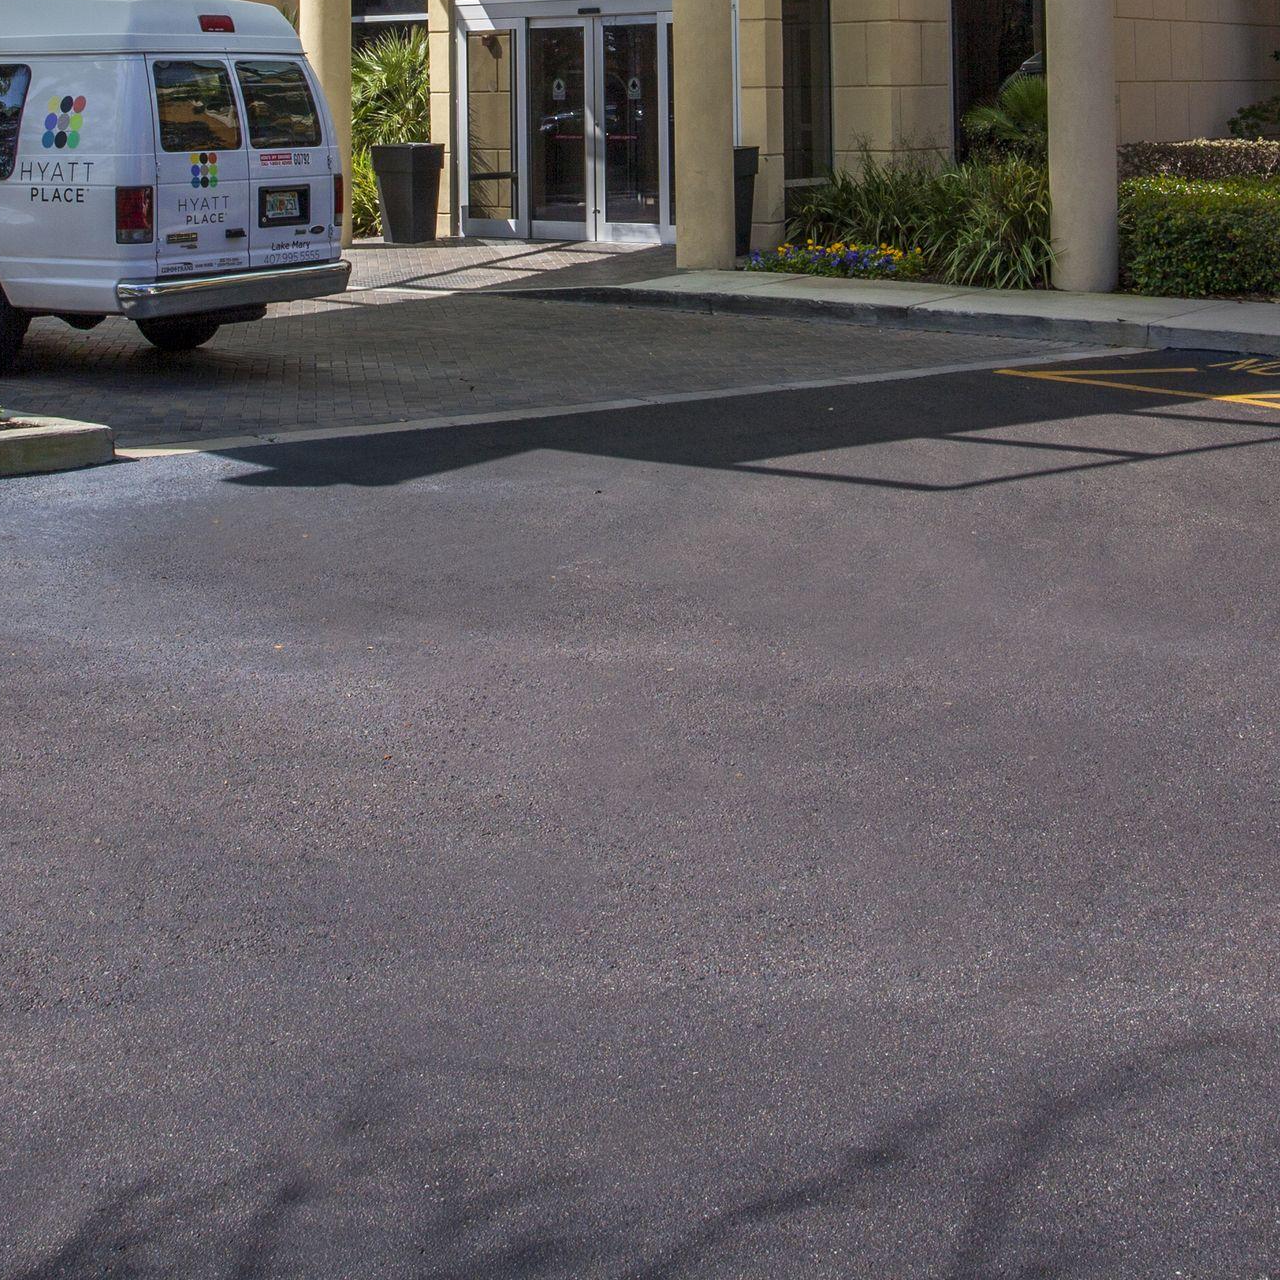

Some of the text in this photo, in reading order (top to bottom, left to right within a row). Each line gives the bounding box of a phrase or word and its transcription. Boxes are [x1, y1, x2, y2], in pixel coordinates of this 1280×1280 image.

[20, 162, 94, 182] HYATT
[30, 187, 85, 203] PLACE
[178, 195, 229, 213] HYATT
[186, 212, 224, 225] PLACE
[271, 240, 310, 251] Lake Mary
